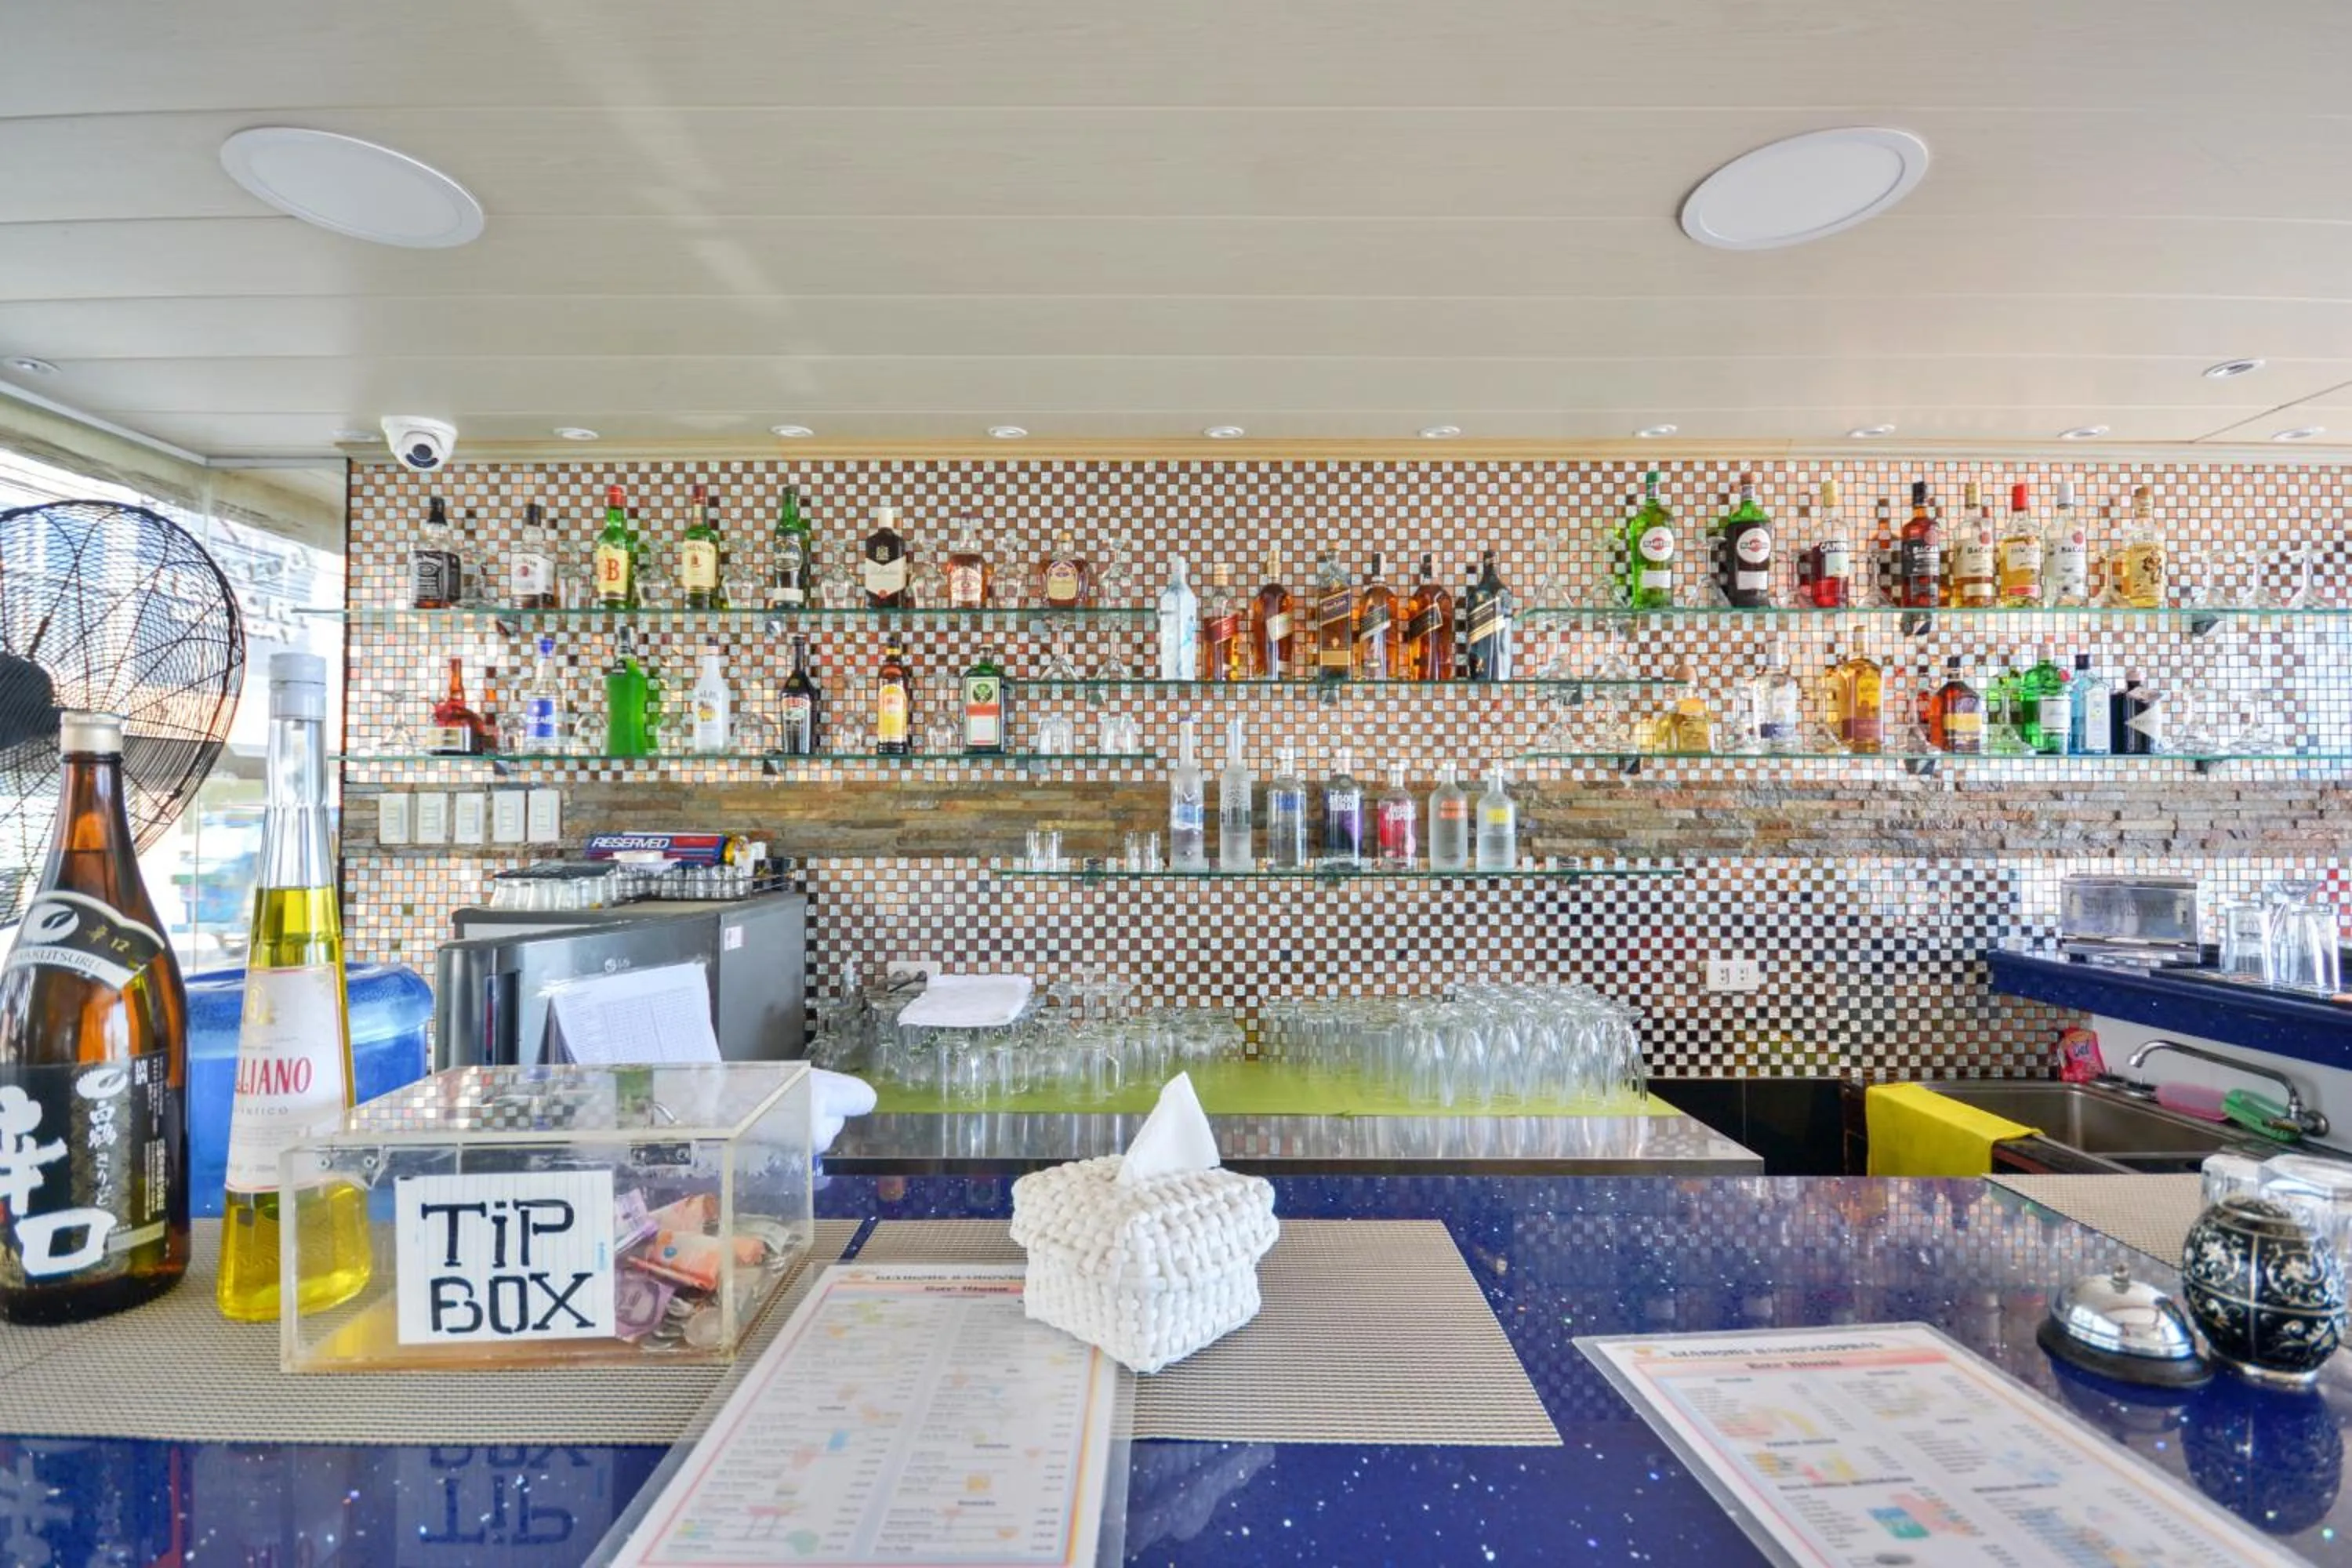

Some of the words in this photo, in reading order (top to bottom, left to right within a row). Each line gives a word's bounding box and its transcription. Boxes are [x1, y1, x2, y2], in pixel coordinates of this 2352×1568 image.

[592, 837, 671, 848] RESERVED
[236, 1057, 313, 1096] LIANO
[430, 1272, 596, 1334] BOX
